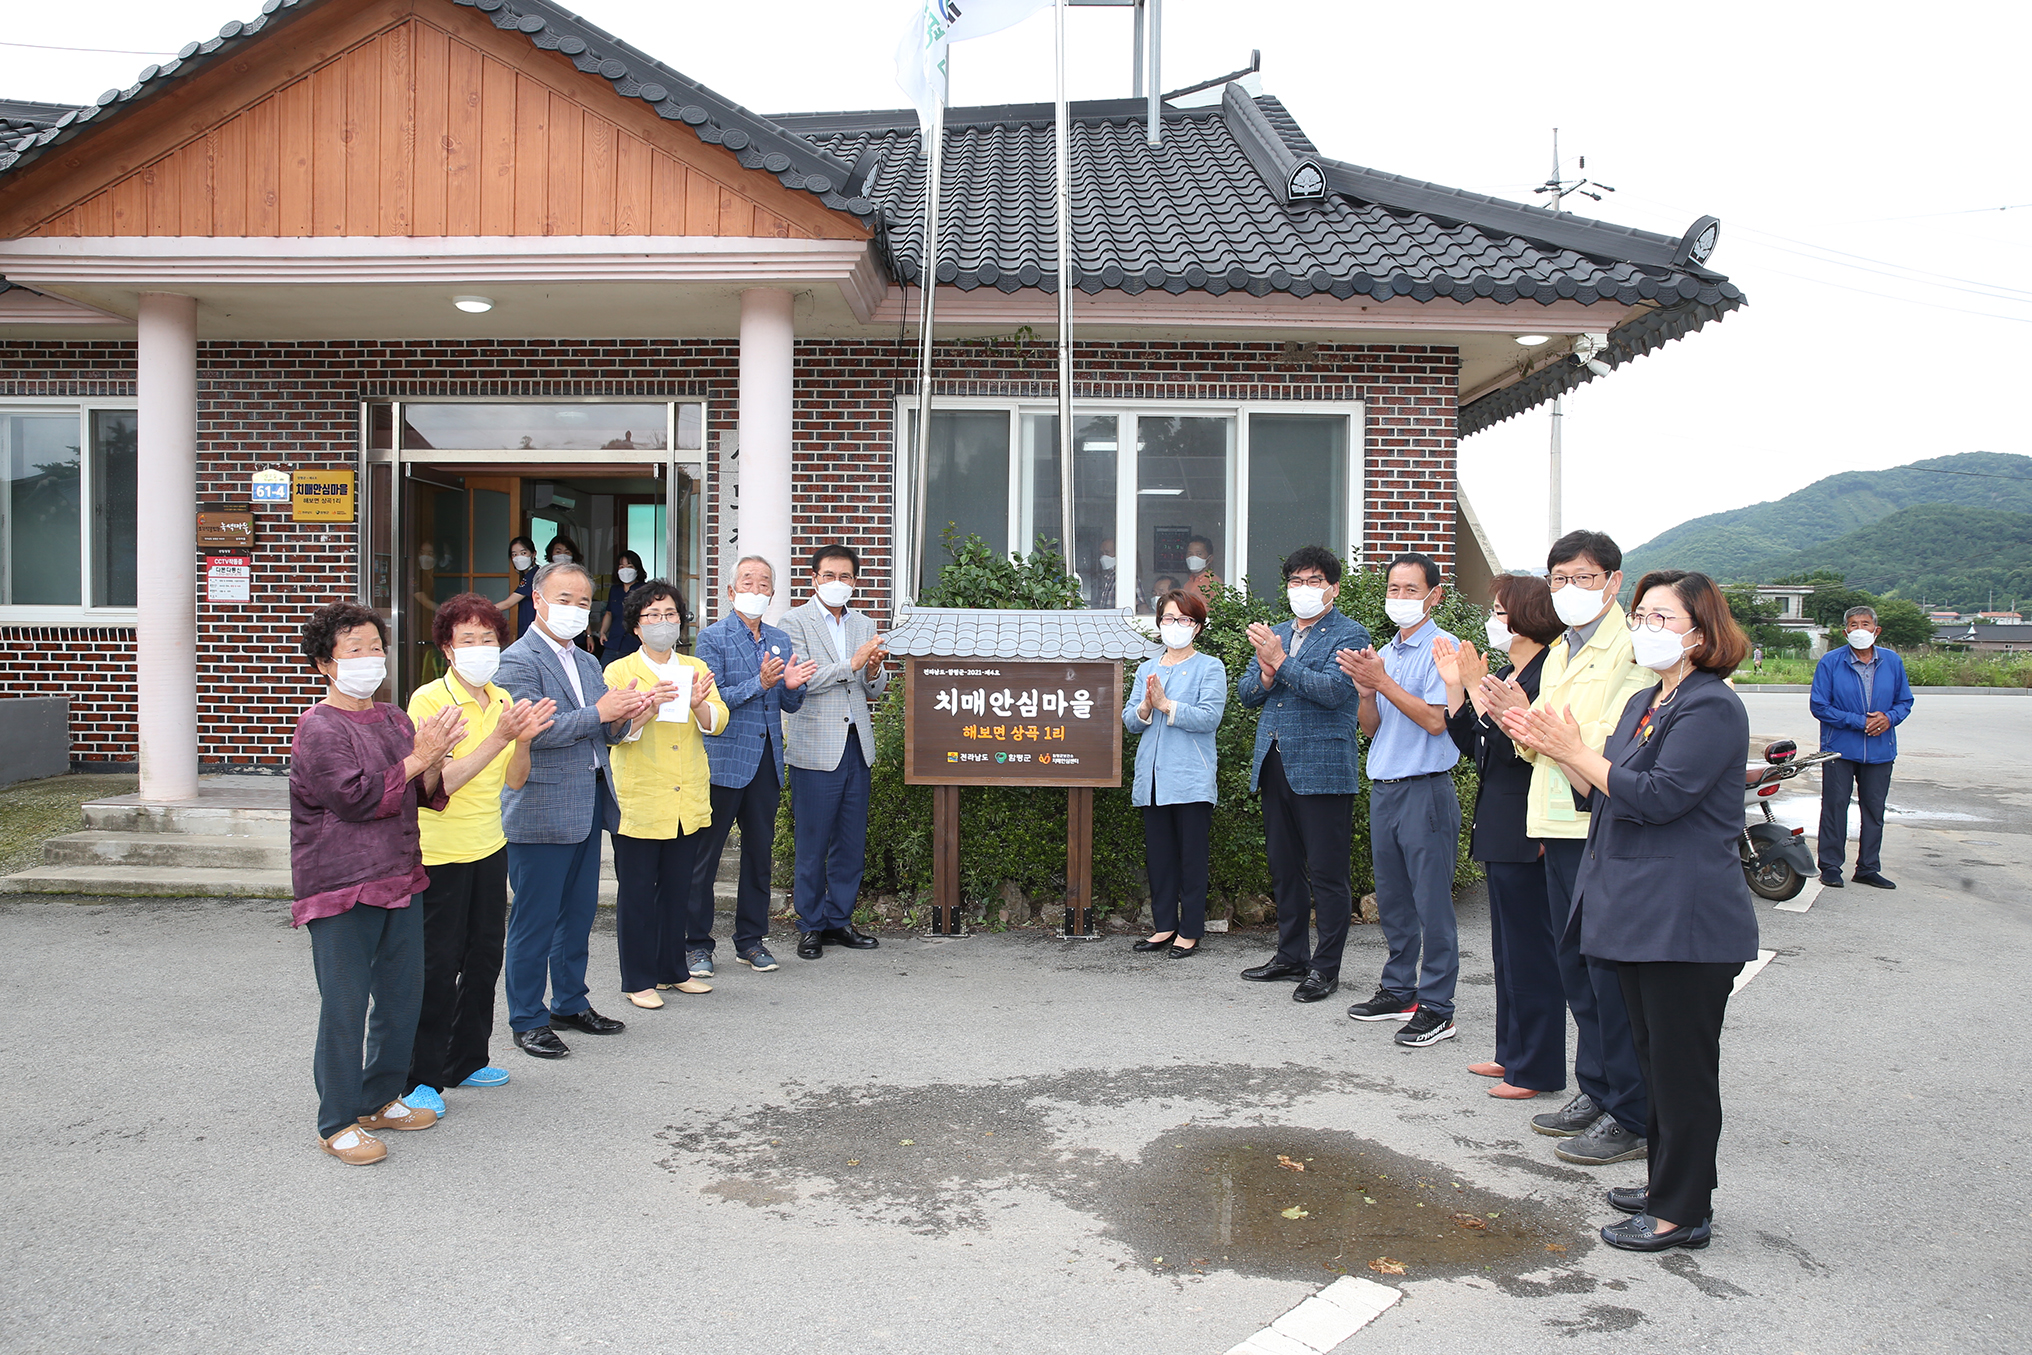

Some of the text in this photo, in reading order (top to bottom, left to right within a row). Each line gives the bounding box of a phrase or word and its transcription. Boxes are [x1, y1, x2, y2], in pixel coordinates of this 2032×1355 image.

[256, 485, 286, 498] 61-4
[296, 483, 348, 496] 치매안심마을
[933, 687, 1095, 719] 치매안심마을
[962, 724, 1065, 741] 해보면 상곡 1리
[960, 753, 989, 762] 전라남도
[1008, 753, 1032, 763] 함평군
[1416, 1020, 1447, 1042] DYNAFIT
